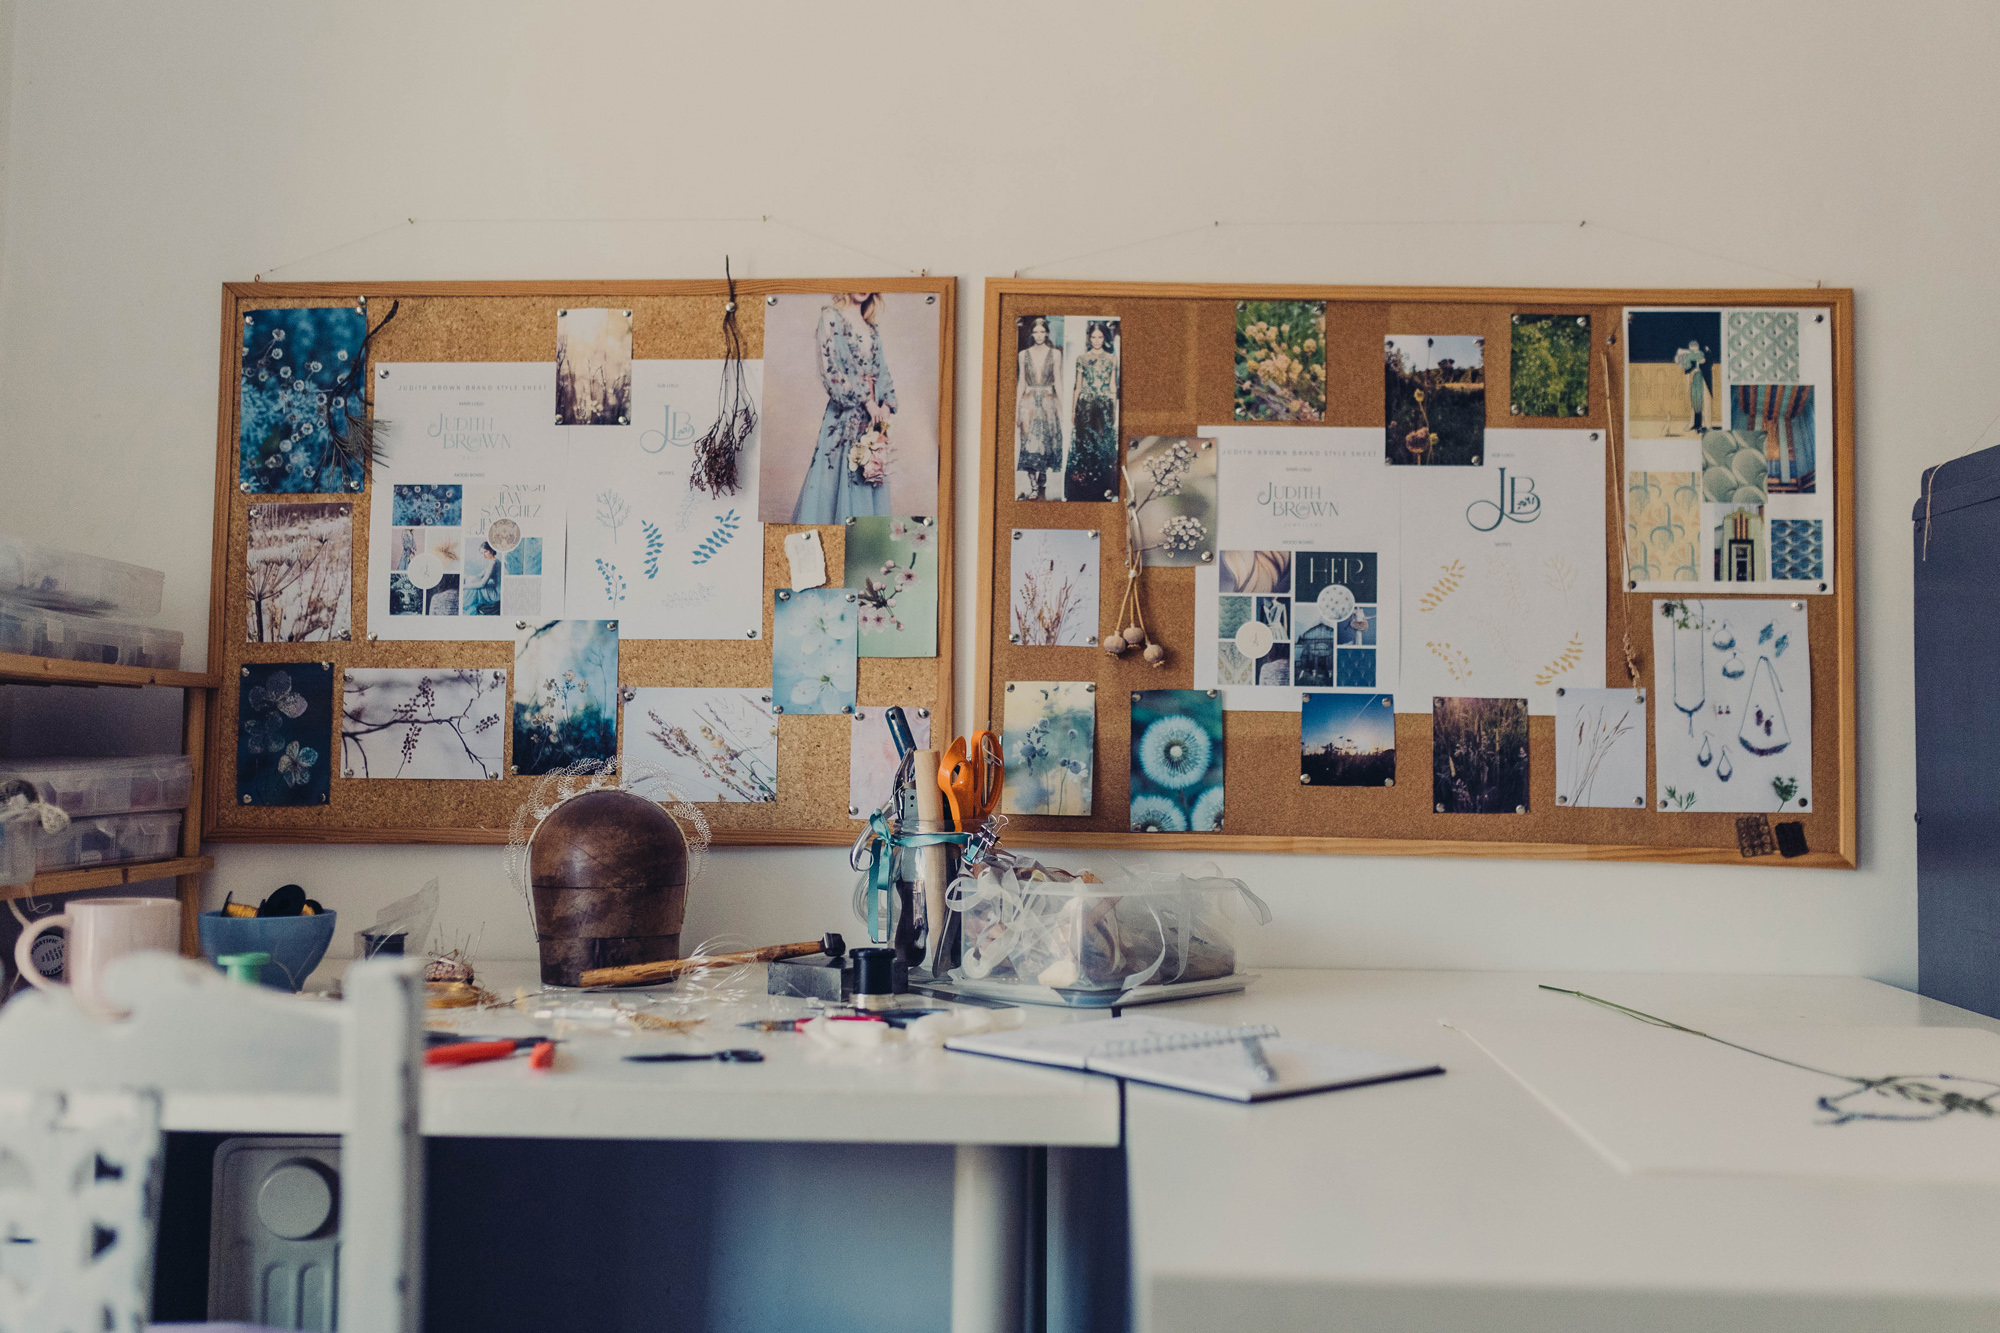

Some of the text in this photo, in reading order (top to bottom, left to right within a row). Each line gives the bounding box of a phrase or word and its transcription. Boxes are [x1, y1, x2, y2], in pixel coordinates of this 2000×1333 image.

[427, 413, 494, 438] JUDITH
[443, 432, 512, 452] BROWN
[1351, 450, 1378, 458] SHEET
[1257, 481, 1321, 506] JUDITH
[1272, 501, 1339, 520] BROWN
